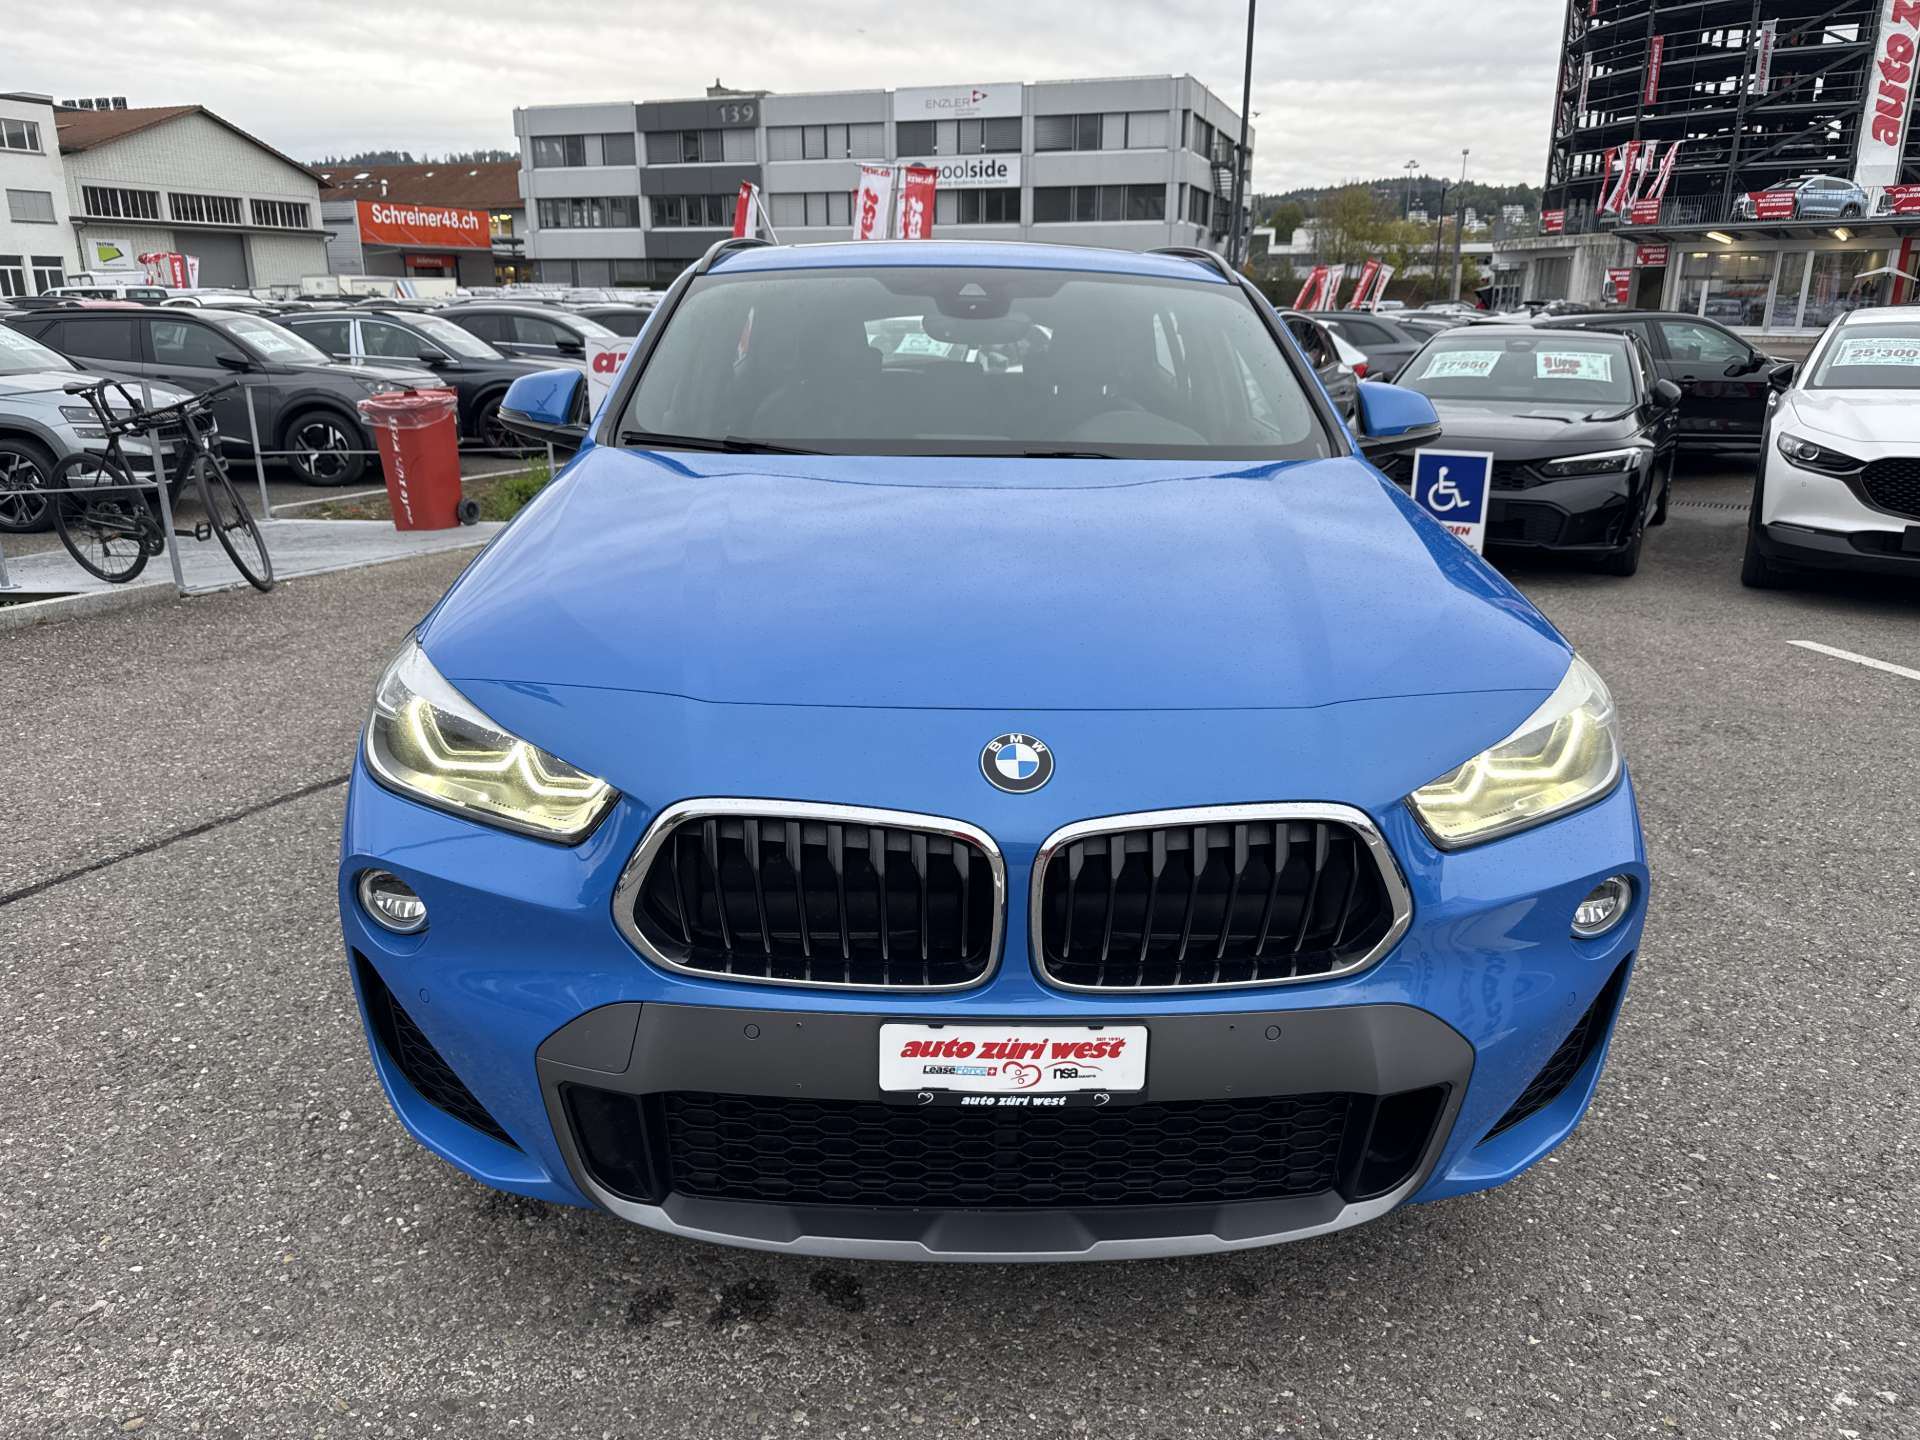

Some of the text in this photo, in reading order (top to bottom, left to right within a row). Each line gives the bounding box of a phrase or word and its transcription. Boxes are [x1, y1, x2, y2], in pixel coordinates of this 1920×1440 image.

[1871, 33, 1914, 147] auto
[925, 98, 970, 109] ENZLER
[720, 105, 754, 122] 139
[371, 203, 480, 230] Schreiner48.ch
[1850, 348, 1919, 358] 25'300
[1447, 526, 1471, 536] DEN
[988, 734, 1047, 753] BMW
[900, 1037, 1126, 1060] auto züri west
[1053, 1067, 1079, 1080] nsa
[960, 1095, 1067, 1106] auto züri west
